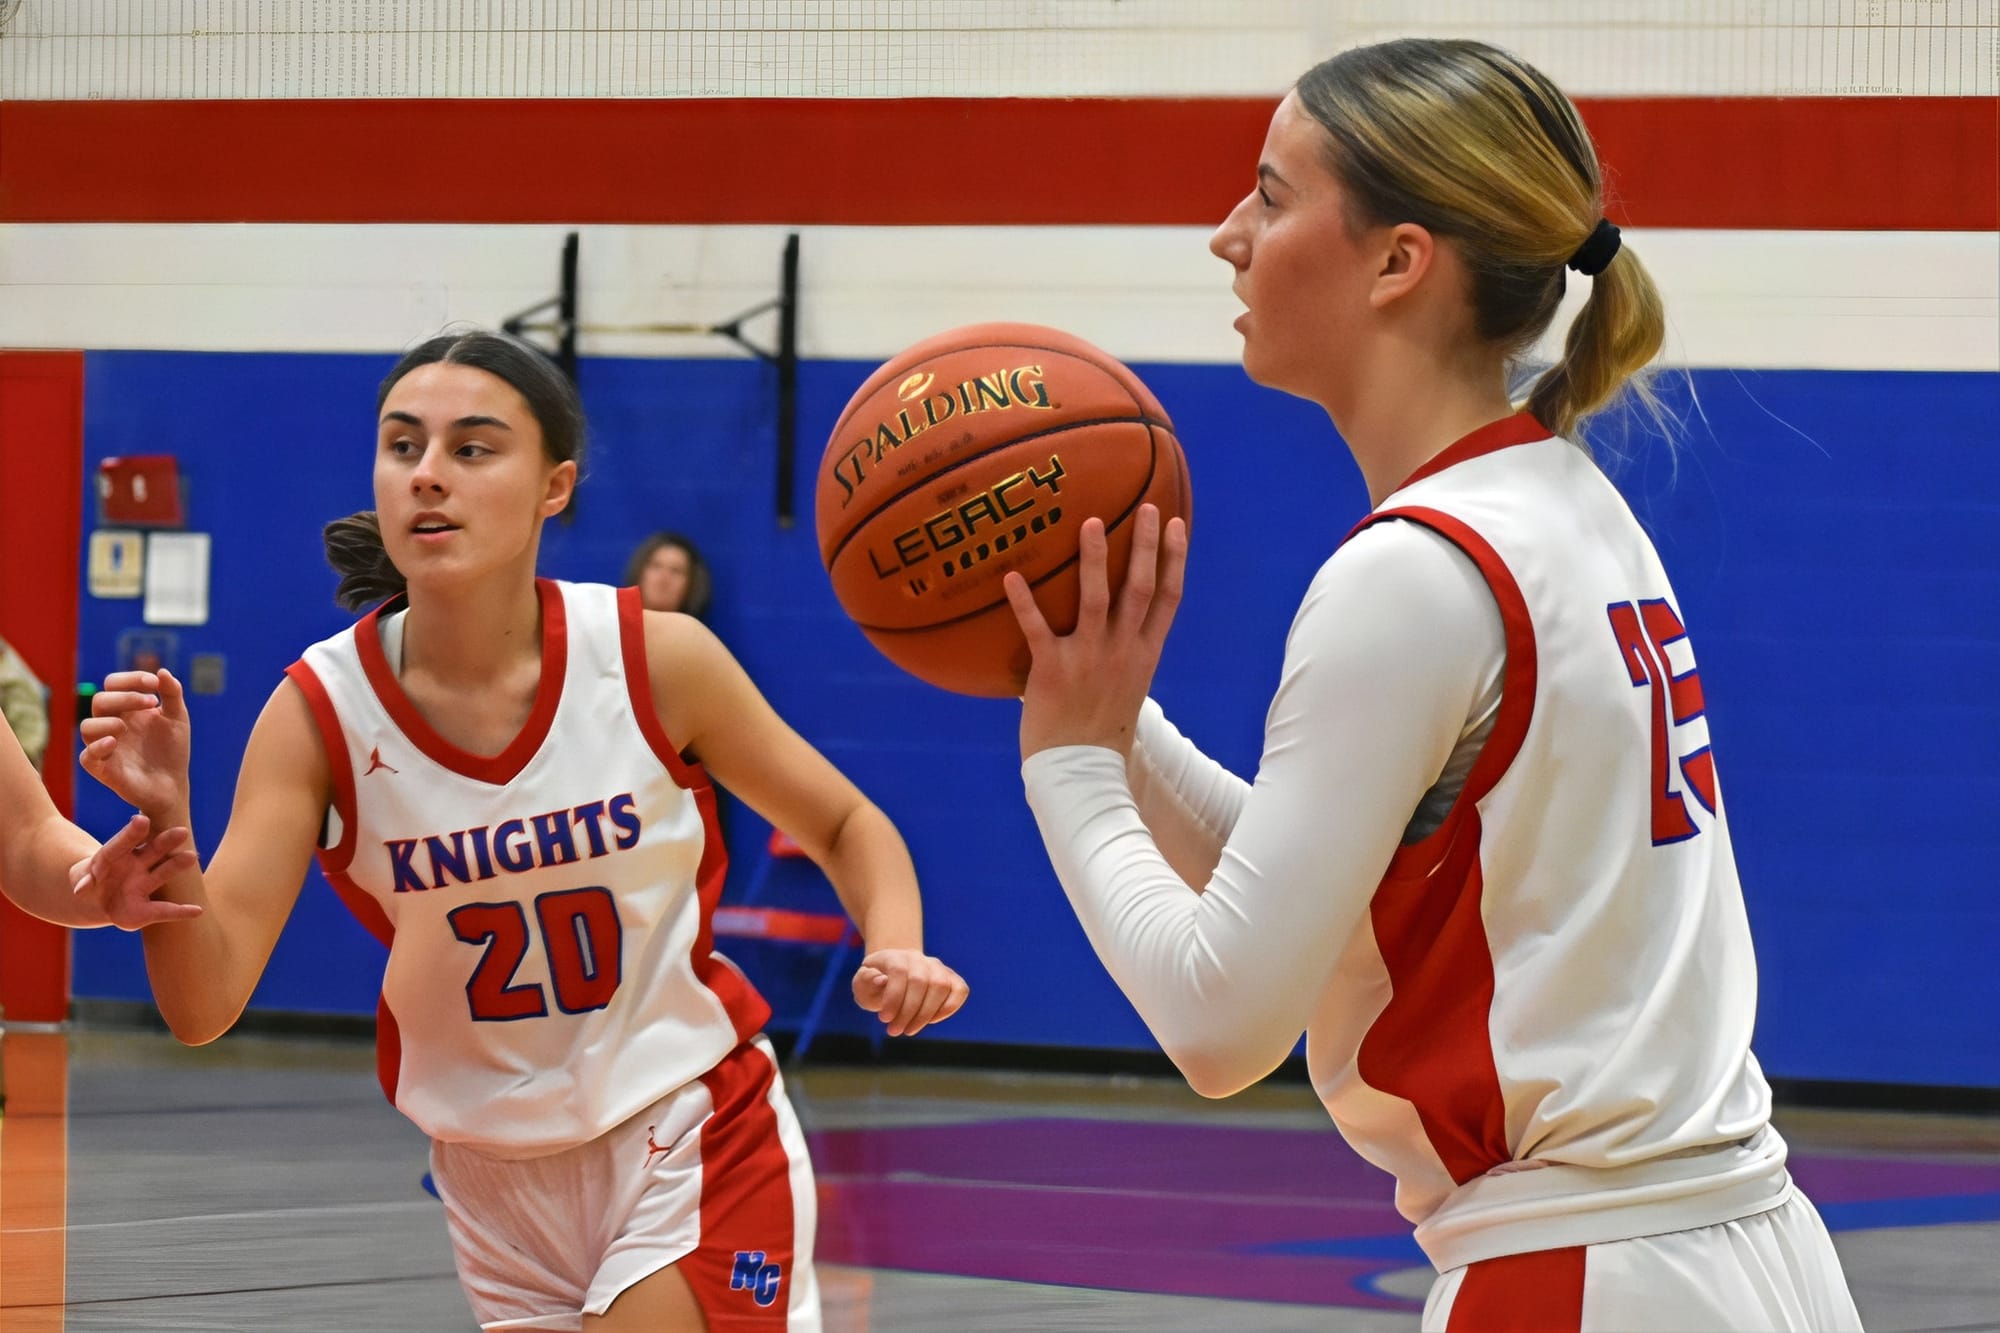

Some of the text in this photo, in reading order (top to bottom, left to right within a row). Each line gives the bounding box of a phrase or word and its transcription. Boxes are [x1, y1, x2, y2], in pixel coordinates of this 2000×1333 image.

[833, 364, 1053, 508] SPALDING
[868, 454, 1067, 580] LEGACY
[383, 793, 641, 893] KNIGHTS
[446, 886, 622, 1022] 20
[729, 1251, 781, 1307] NC
